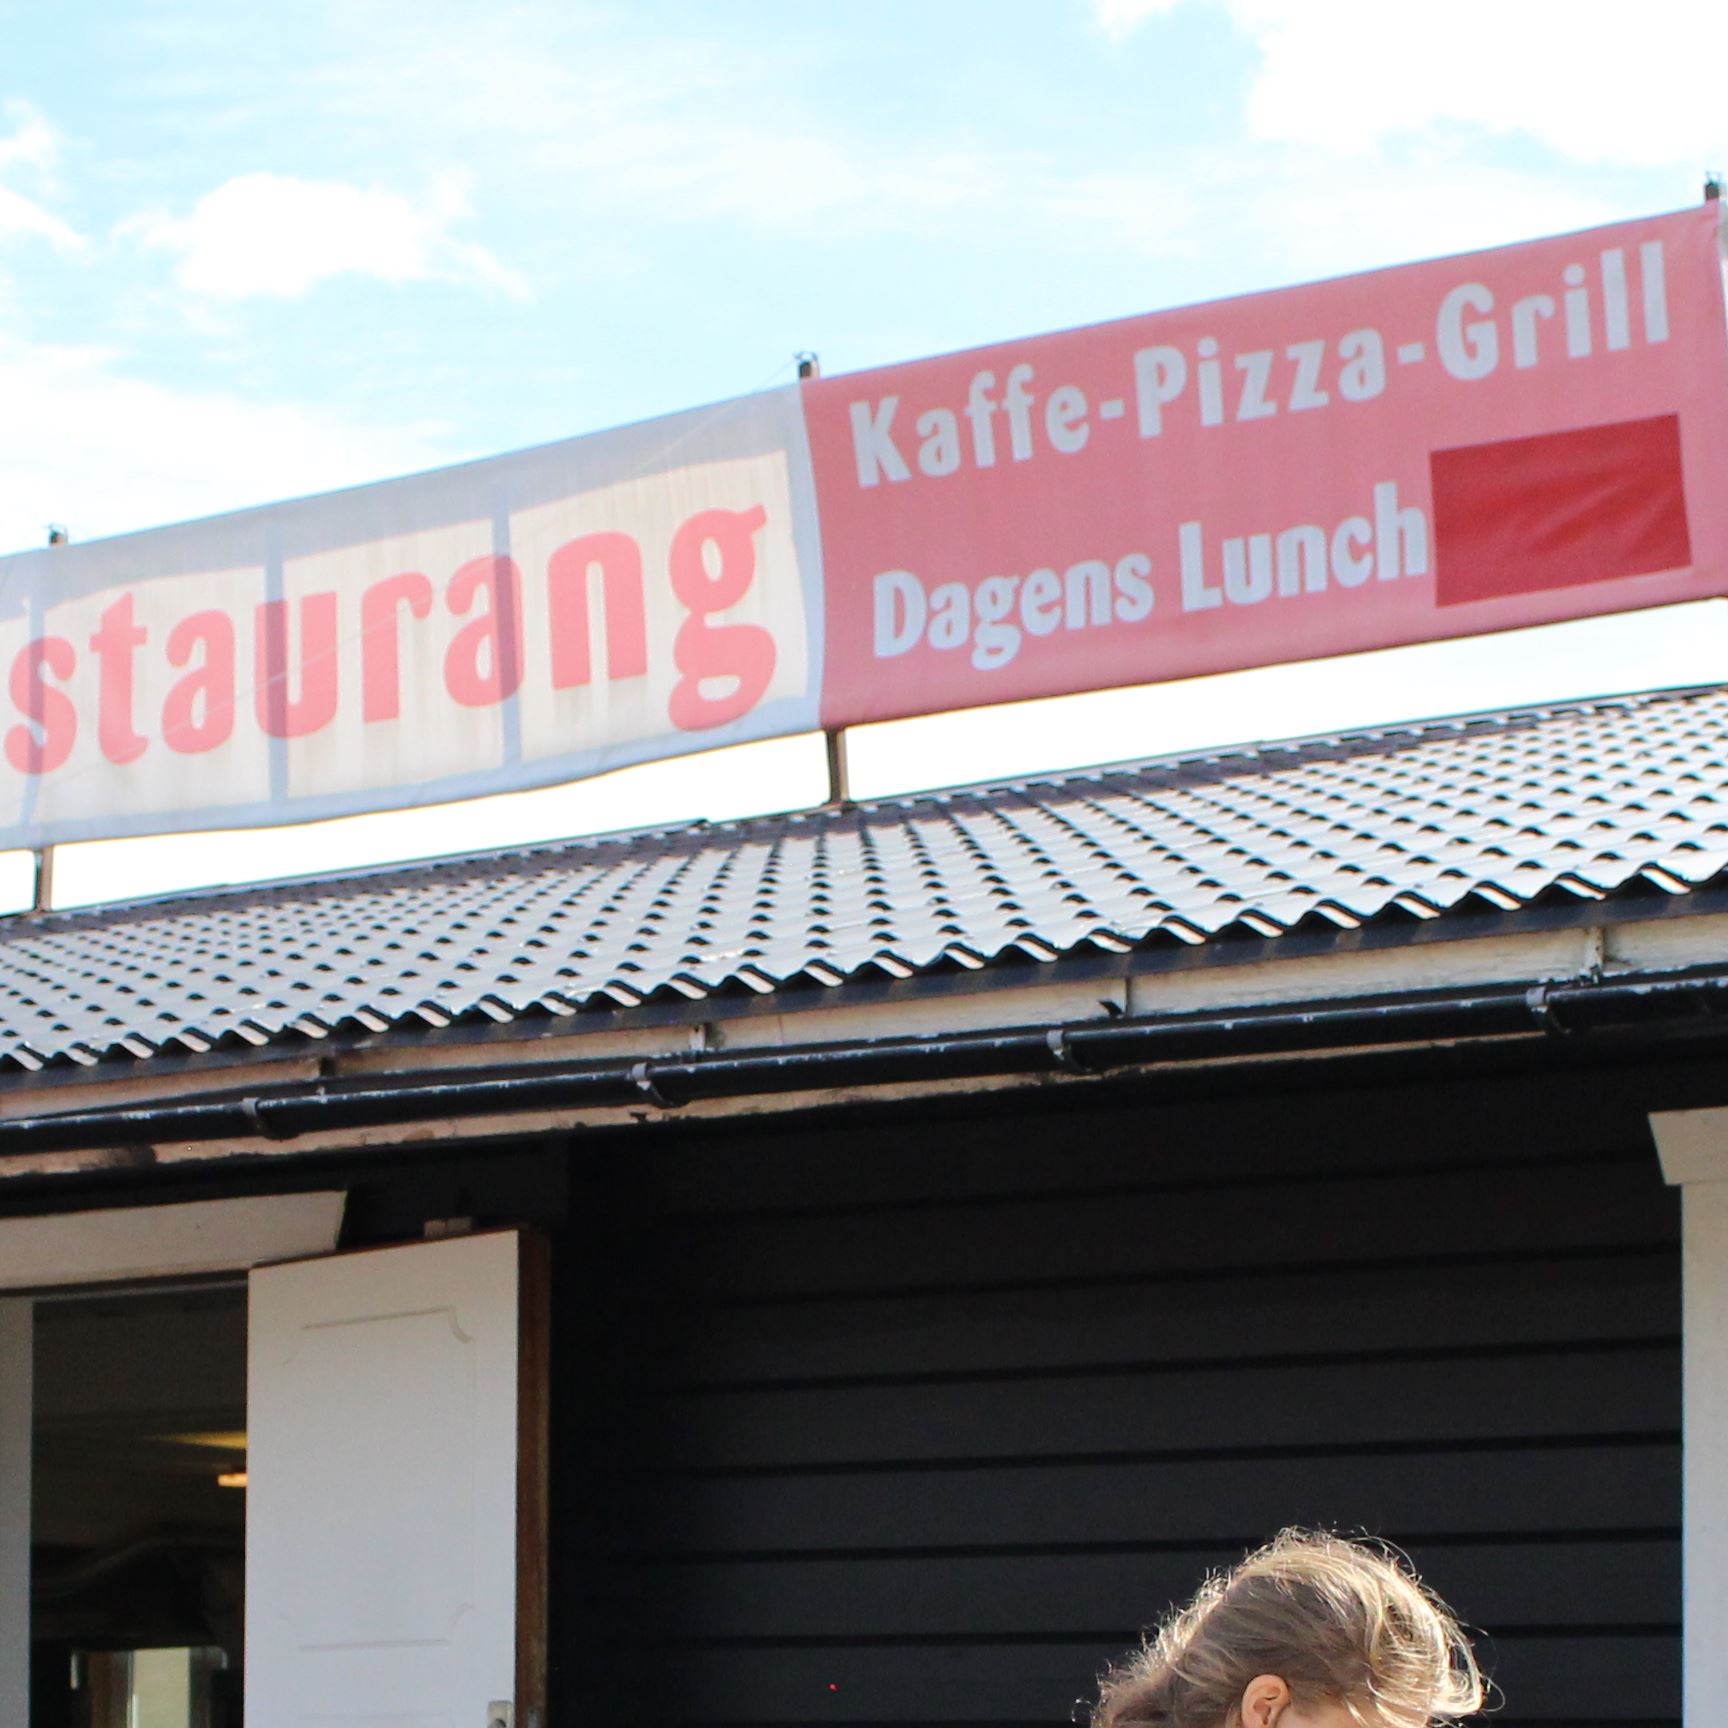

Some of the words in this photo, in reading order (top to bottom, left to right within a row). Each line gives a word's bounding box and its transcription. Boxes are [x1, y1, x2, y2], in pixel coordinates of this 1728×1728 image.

[849, 240, 1669, 487] Kaffe-Pizza-Grill
[873, 551, 1155, 670] Dagens
[1178, 481, 1428, 613] Lunch
